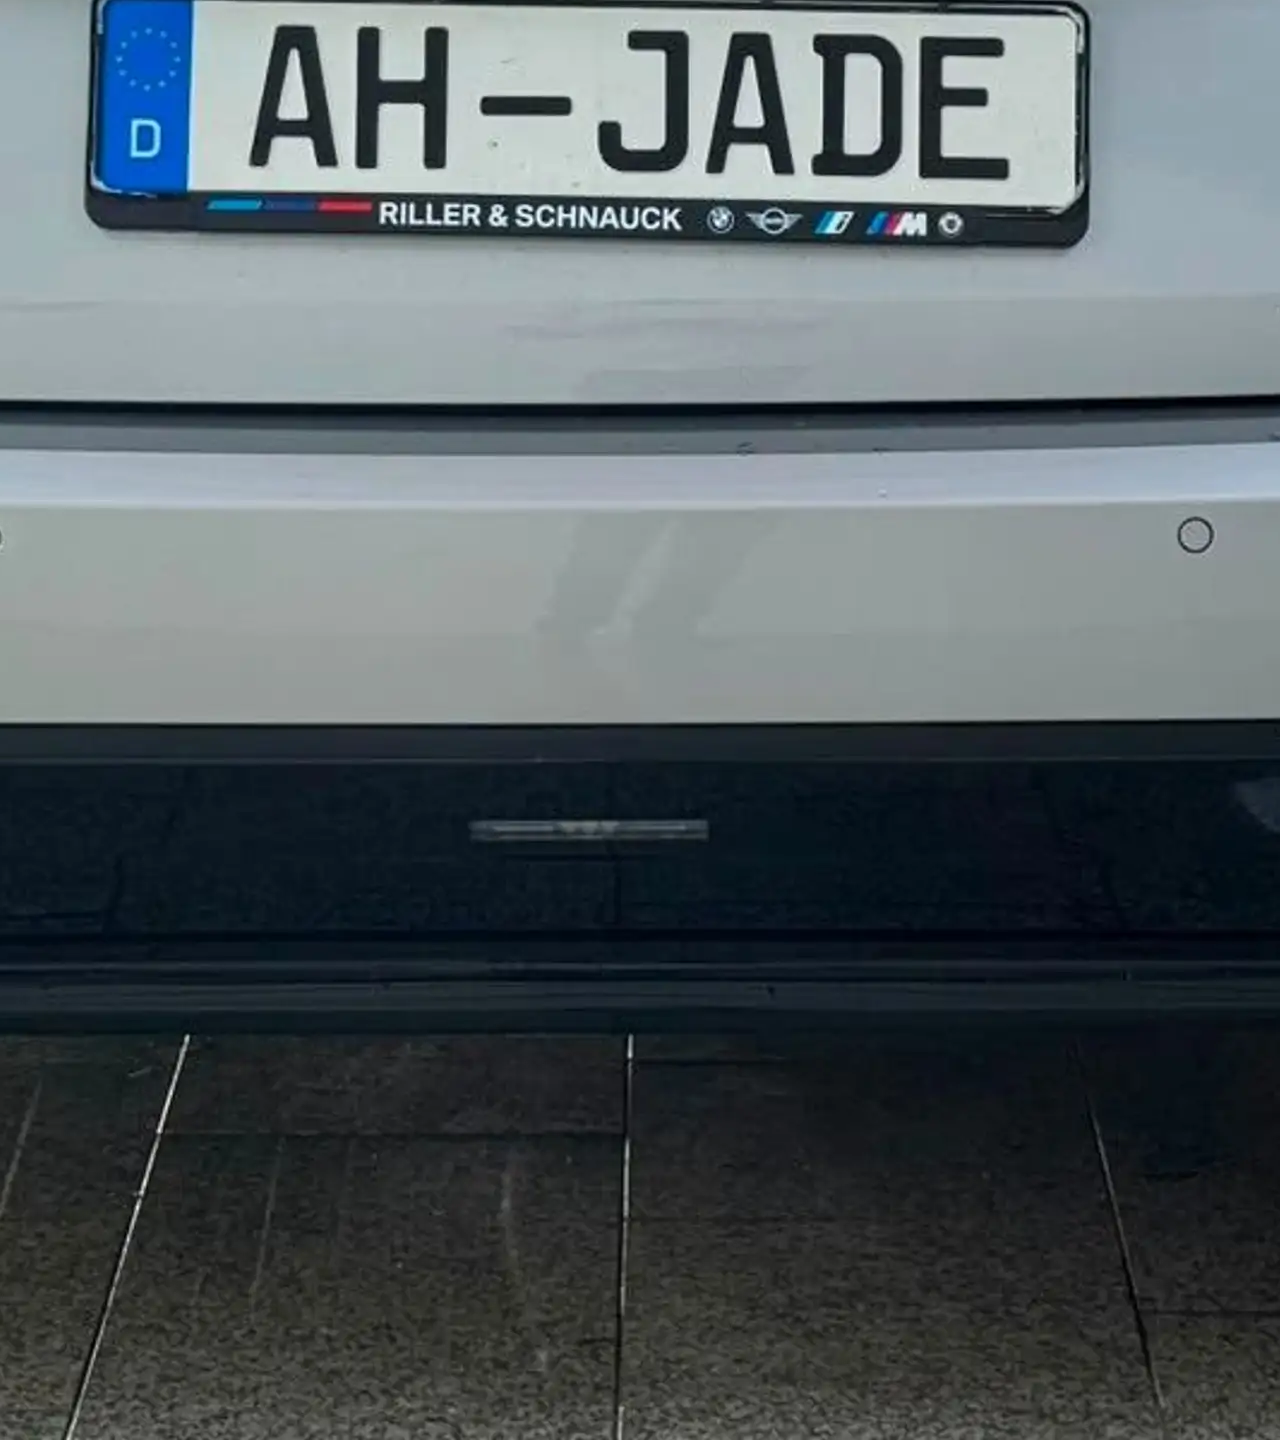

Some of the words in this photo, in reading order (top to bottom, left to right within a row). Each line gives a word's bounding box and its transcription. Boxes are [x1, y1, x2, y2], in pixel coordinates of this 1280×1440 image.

[130, 118, 162, 158] D
[379, 201, 481, 227] RILLER
[488, 203, 509, 228] &
[514, 203, 682, 231] SCHNAUCK
